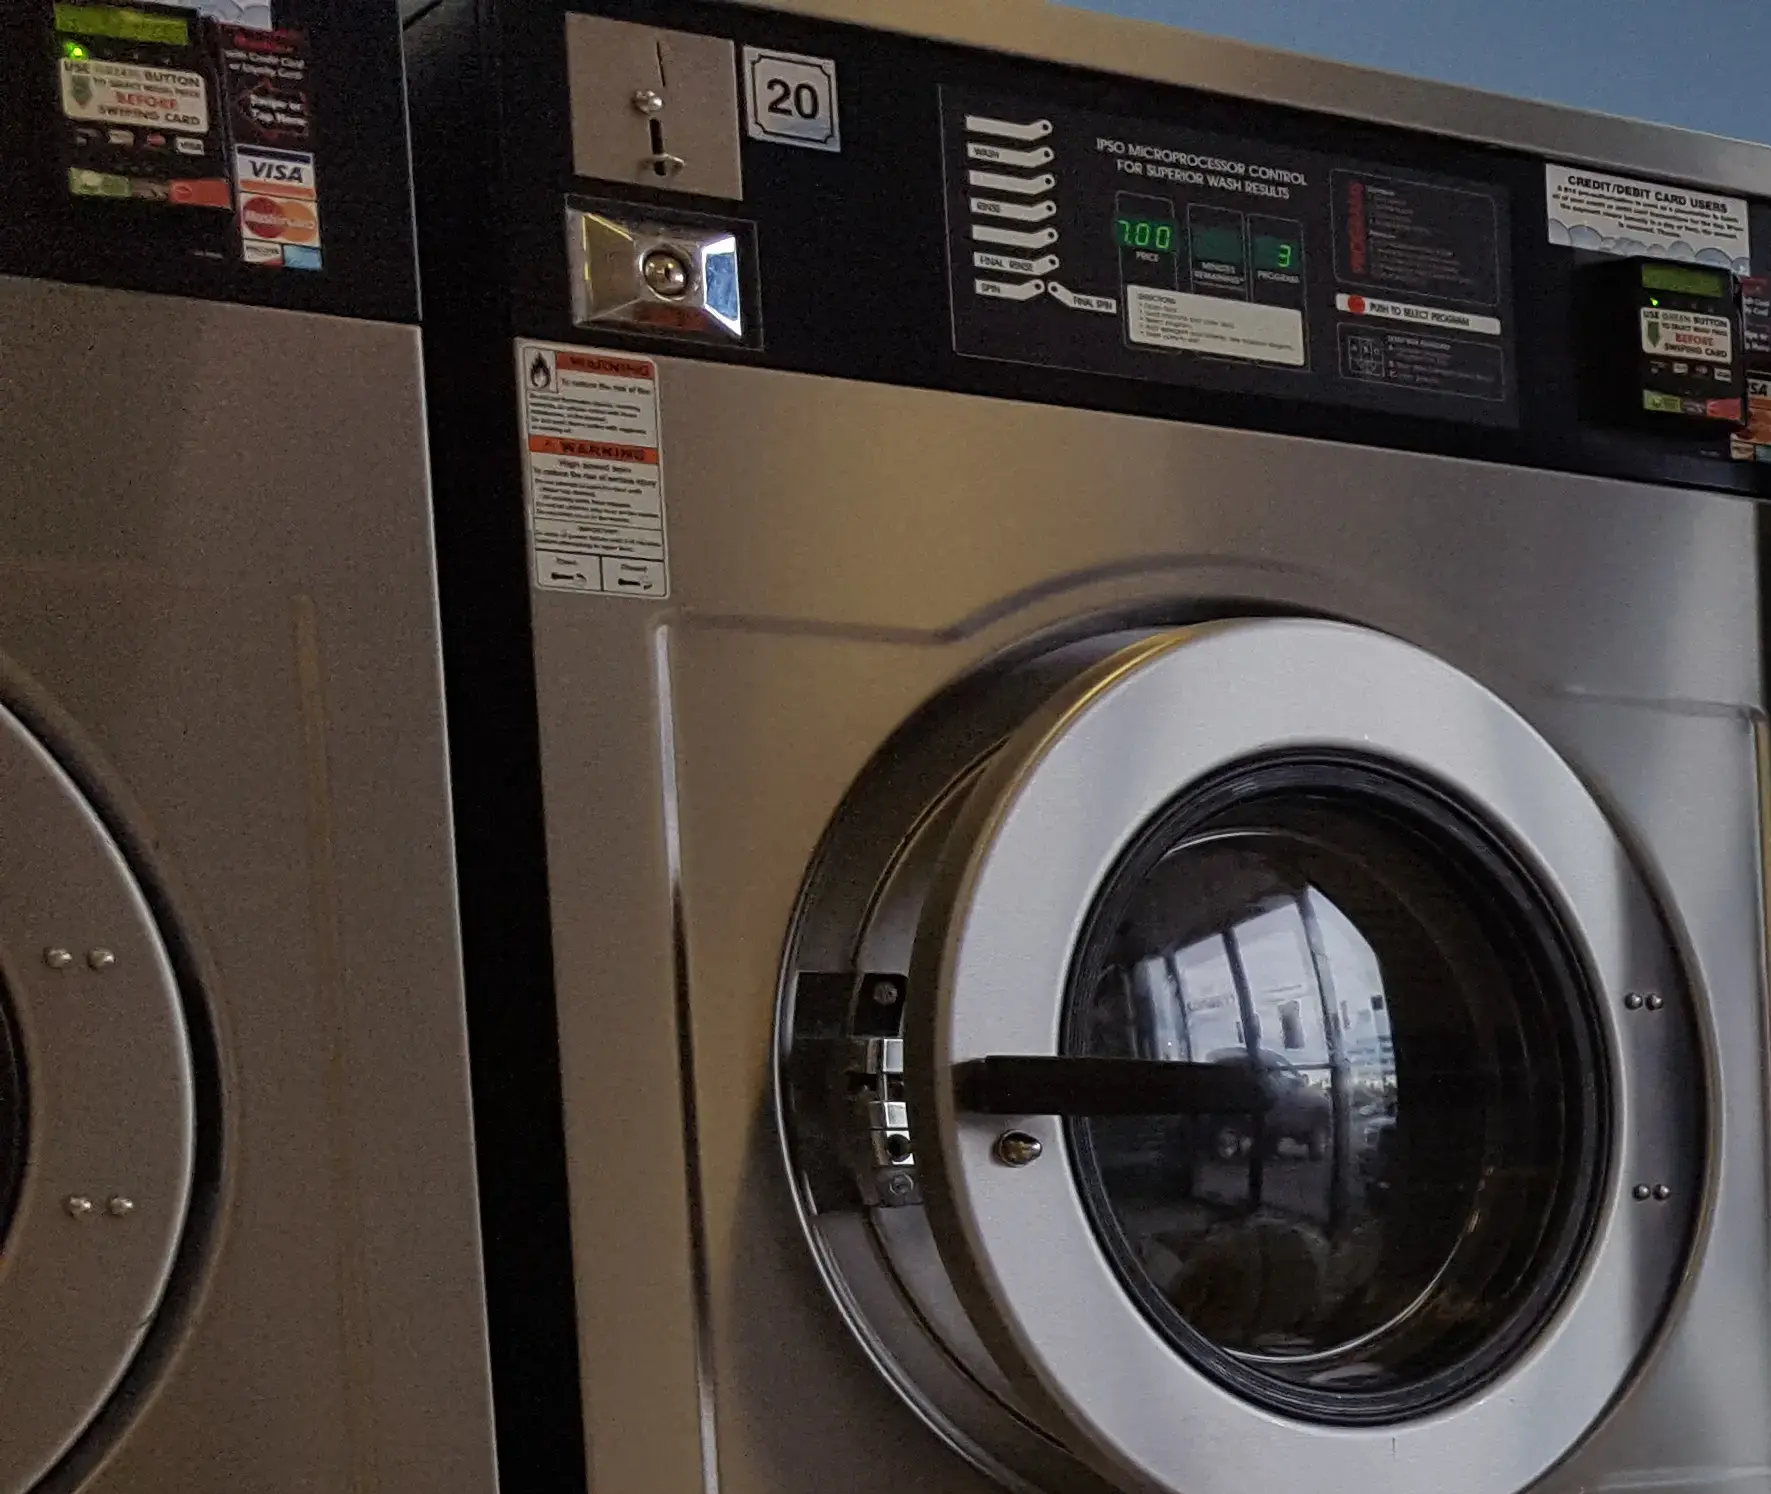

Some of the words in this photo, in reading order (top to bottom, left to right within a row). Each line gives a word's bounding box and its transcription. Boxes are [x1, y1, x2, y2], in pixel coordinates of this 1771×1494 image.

[145, 71, 200, 87] BUTTON
[767, 78, 820, 120] 20
[164, 113, 200, 126] CARD
[249, 160, 303, 184] VISA
[1096, 138, 1125, 155] IPSO
[1129, 144, 1245, 175] MICROPROCESSOR
[1250, 165, 1308, 186] CONTROL
[1116, 159, 1142, 175] FOR
[1146, 165, 1204, 185] SUPERIOR
[1207, 174, 1242, 191] WASH
[1244, 182, 1290, 199] RESULTS
[1568, 175, 1651, 199] CREDIT/DEBIT
[1654, 191, 1687, 207] CARD
[1690, 198, 1728, 214] USERS
[1278, 244, 1292, 268] 3
[1369, 302, 1389, 313] PUSH
[1391, 305, 1401, 315] TO
[1403, 308, 1428, 320] SELECT
[1431, 312, 1470, 327] PROGRAM
[1693, 315, 1728, 328] BUTTON
[1705, 348, 1728, 358] CARD
